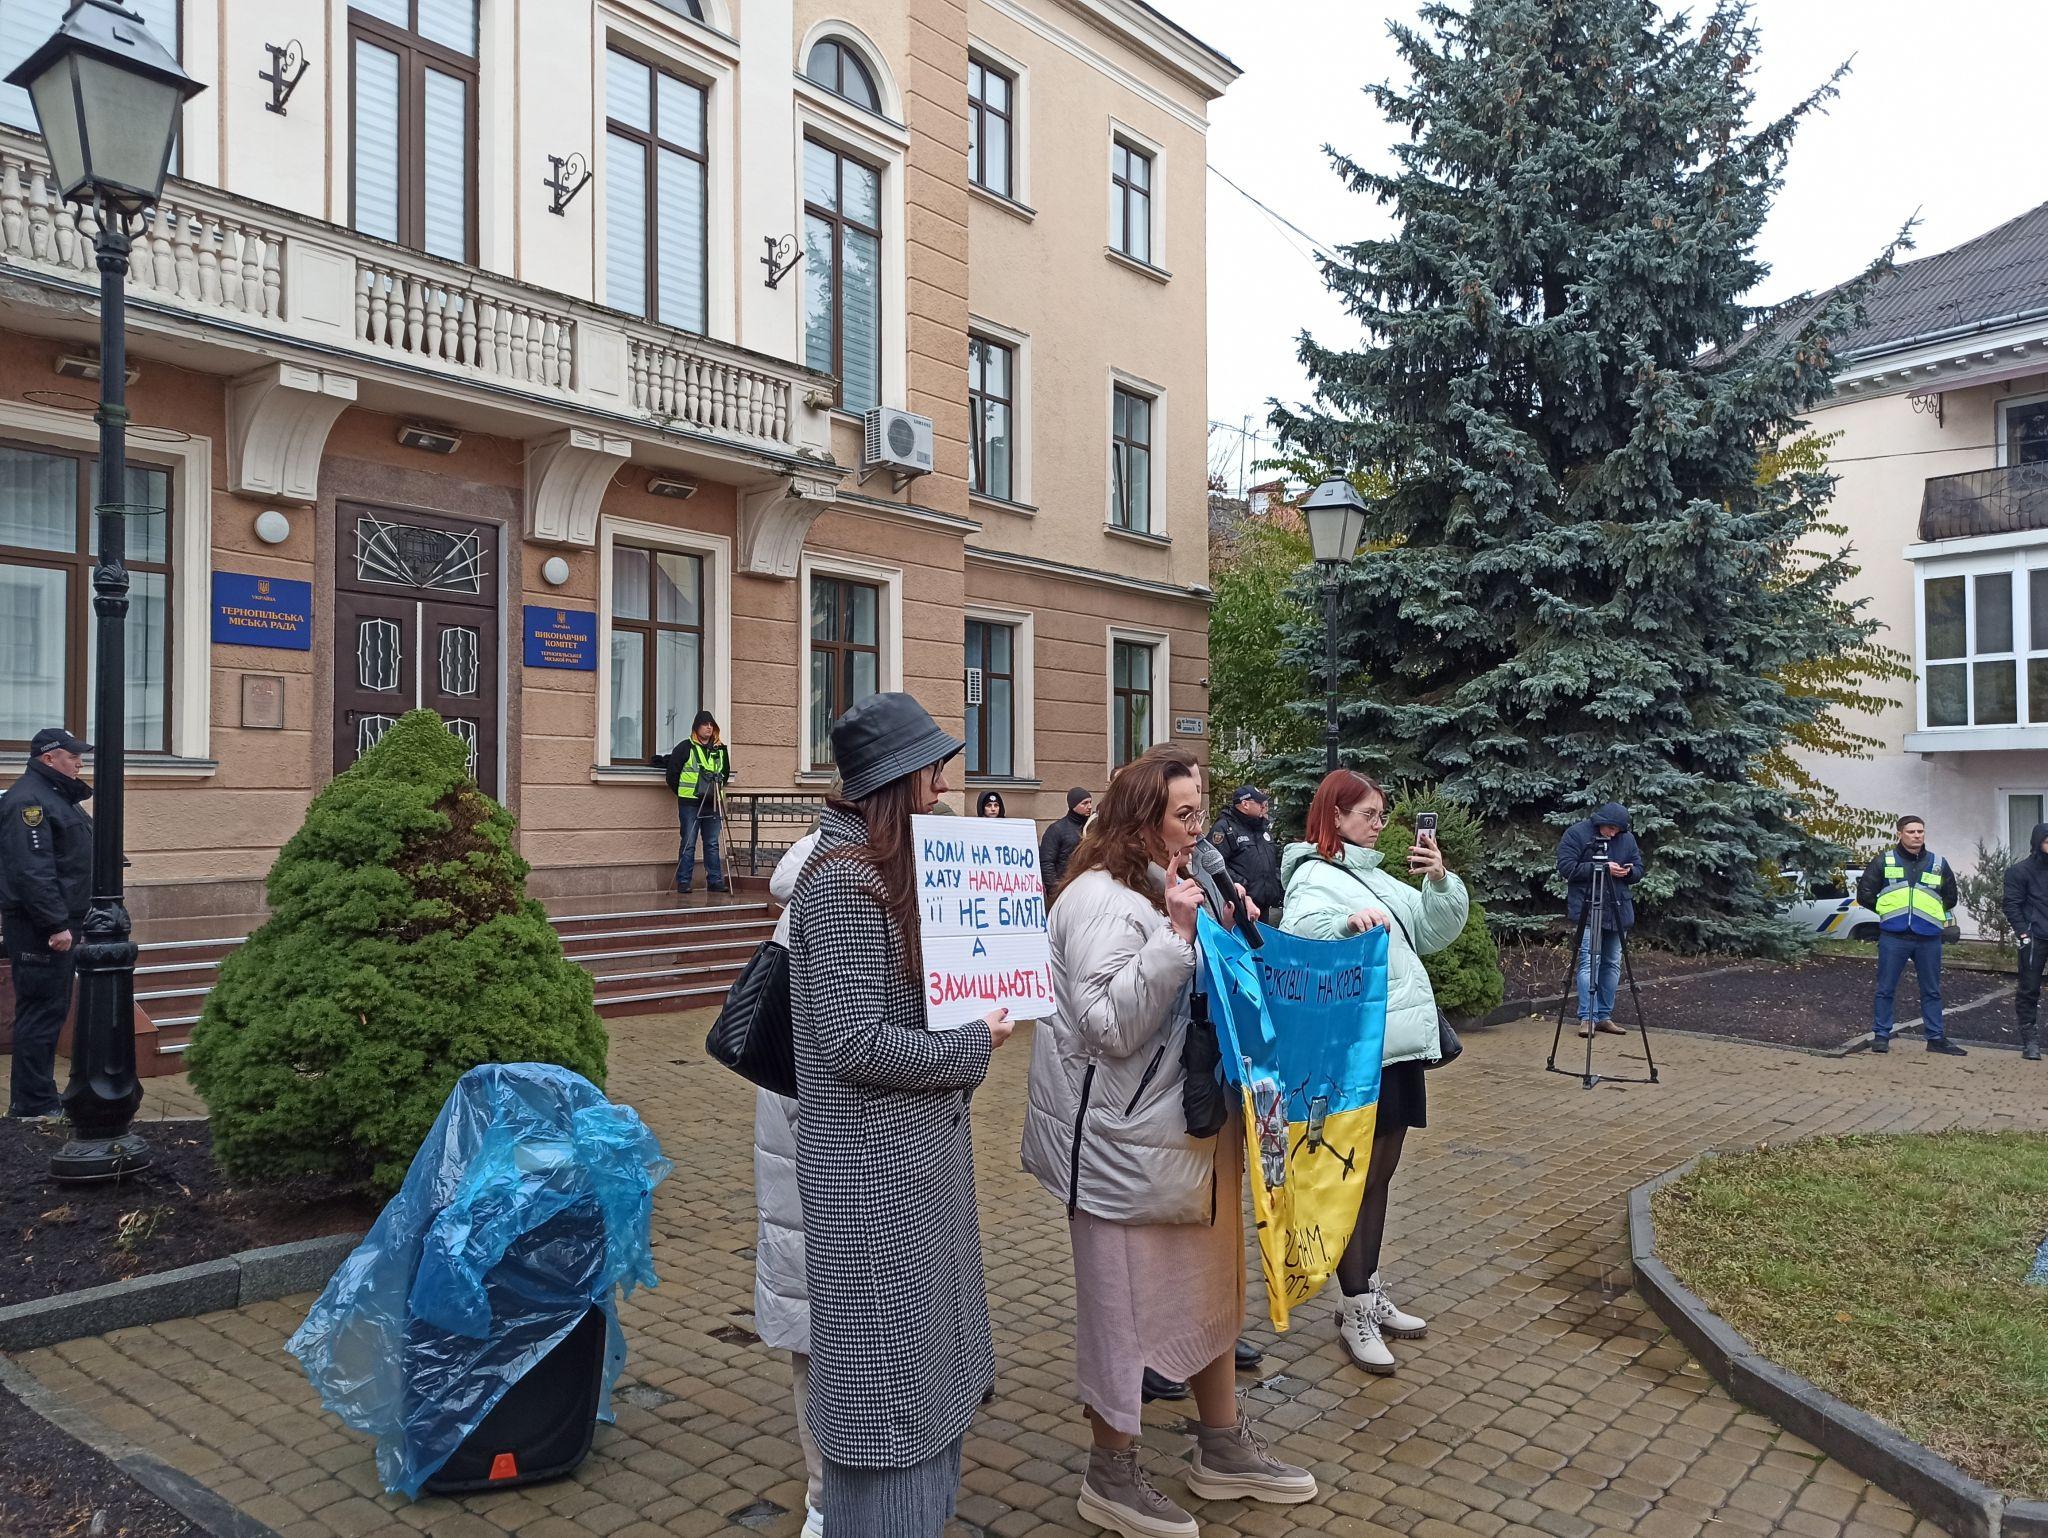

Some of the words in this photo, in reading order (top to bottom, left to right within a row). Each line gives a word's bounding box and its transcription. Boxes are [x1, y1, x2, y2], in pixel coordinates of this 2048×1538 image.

[221, 606, 304, 622] ТЕРНОПІЛЬСЬКА
[229, 617, 268, 628] МІСЬКА
[270, 621, 296, 631] РАДА
[535, 631, 587, 642] ВИКОНАВЧИЙ
[545, 640, 577, 649] КОМІТЕТ
[924, 838, 965, 863] КОЛИ
[971, 844, 992, 866] НА
[995, 845, 1034, 869] ТВОЮ
[924, 869, 961, 888] ХАТУ
[959, 898, 989, 929] НЕ
[972, 936, 987, 957] А
[929, 961, 1054, 1006] ЗАХИЩАЮТЬ!
